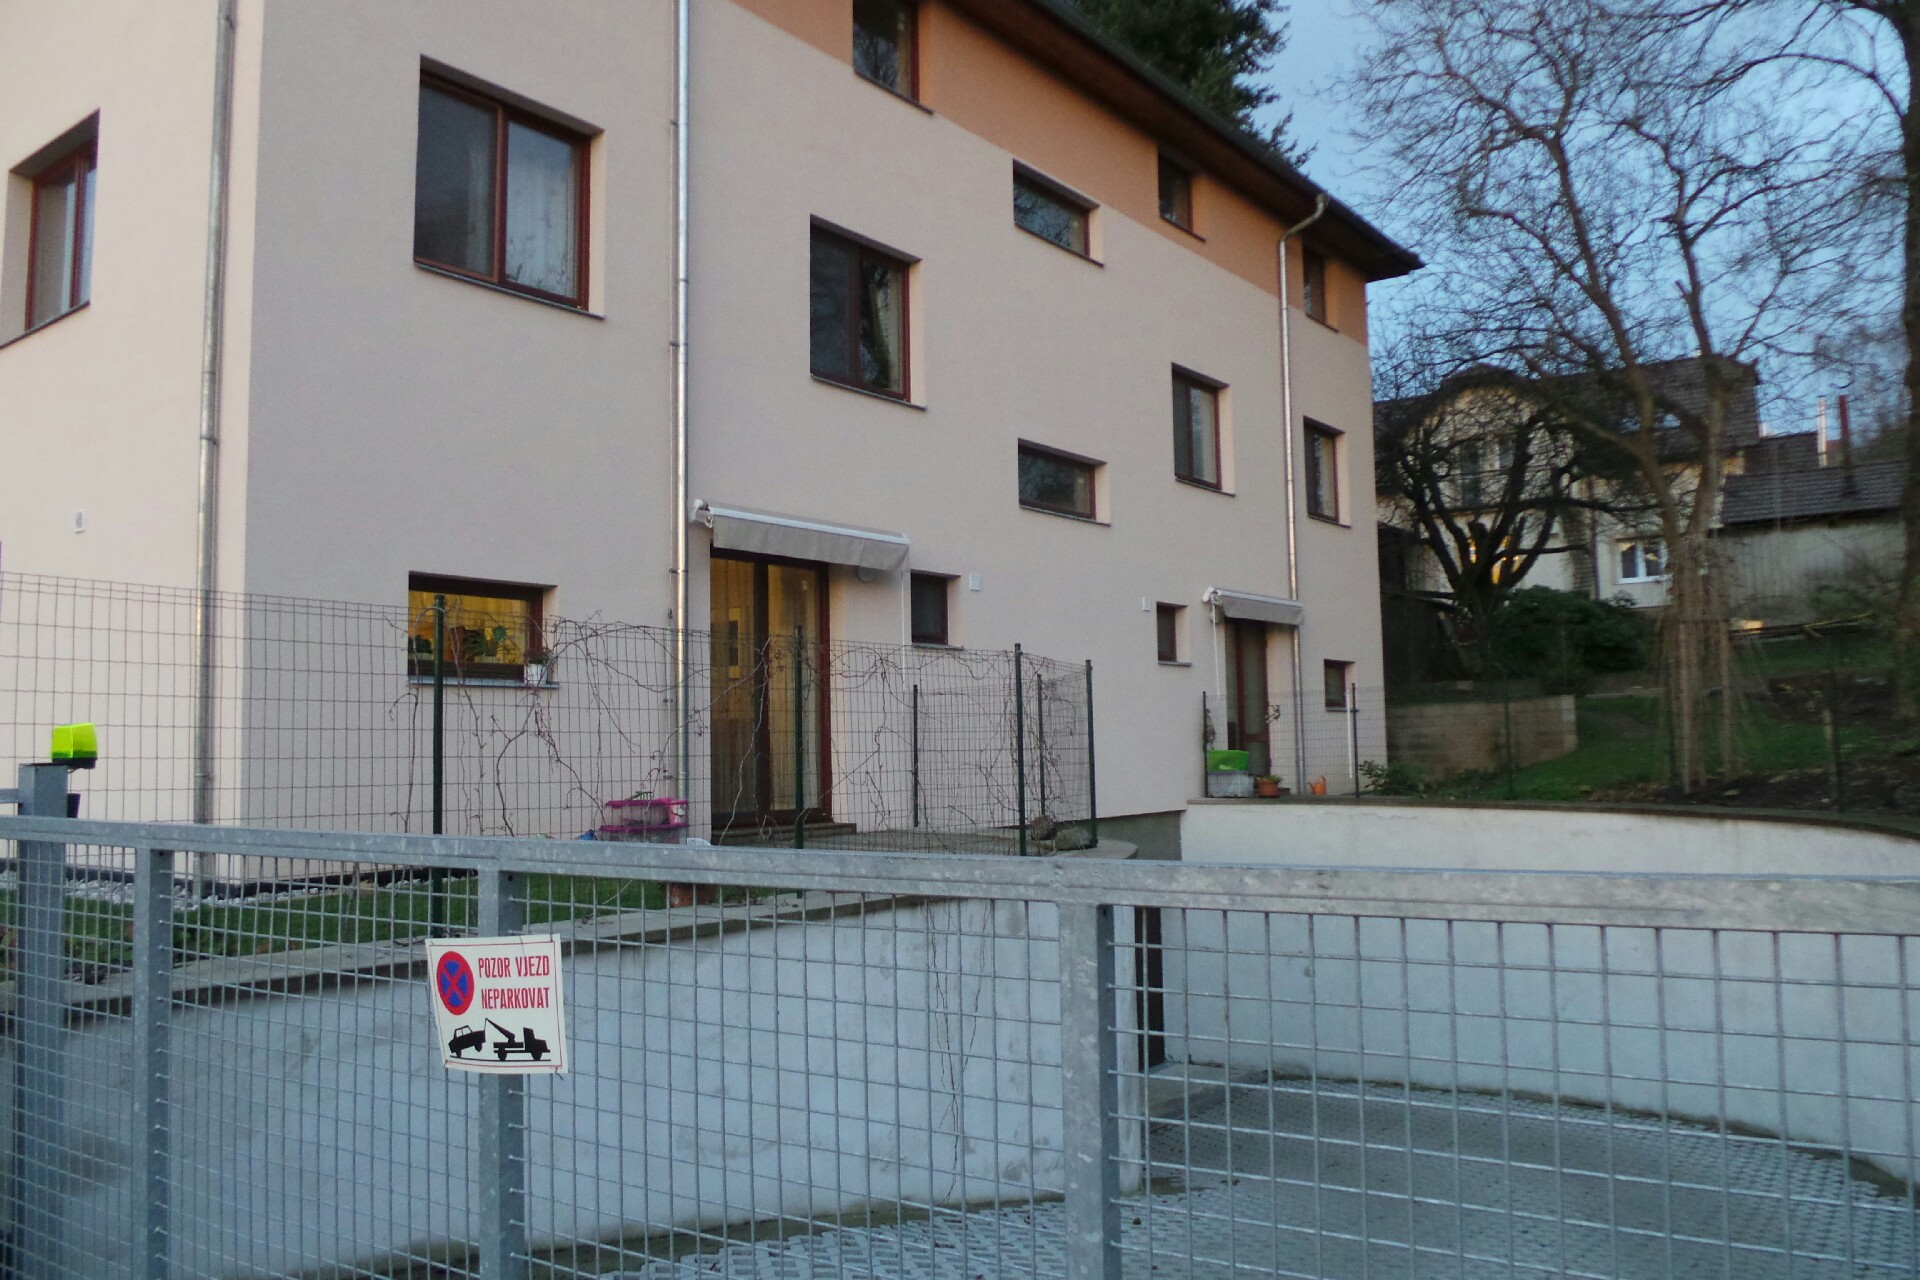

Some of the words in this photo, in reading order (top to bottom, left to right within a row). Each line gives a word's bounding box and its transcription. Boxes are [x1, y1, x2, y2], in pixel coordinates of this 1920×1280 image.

[478, 957, 511, 978] POZOR
[515, 955, 550, 977] VJEZD
[481, 987, 550, 1010] NEPARKOVAT
